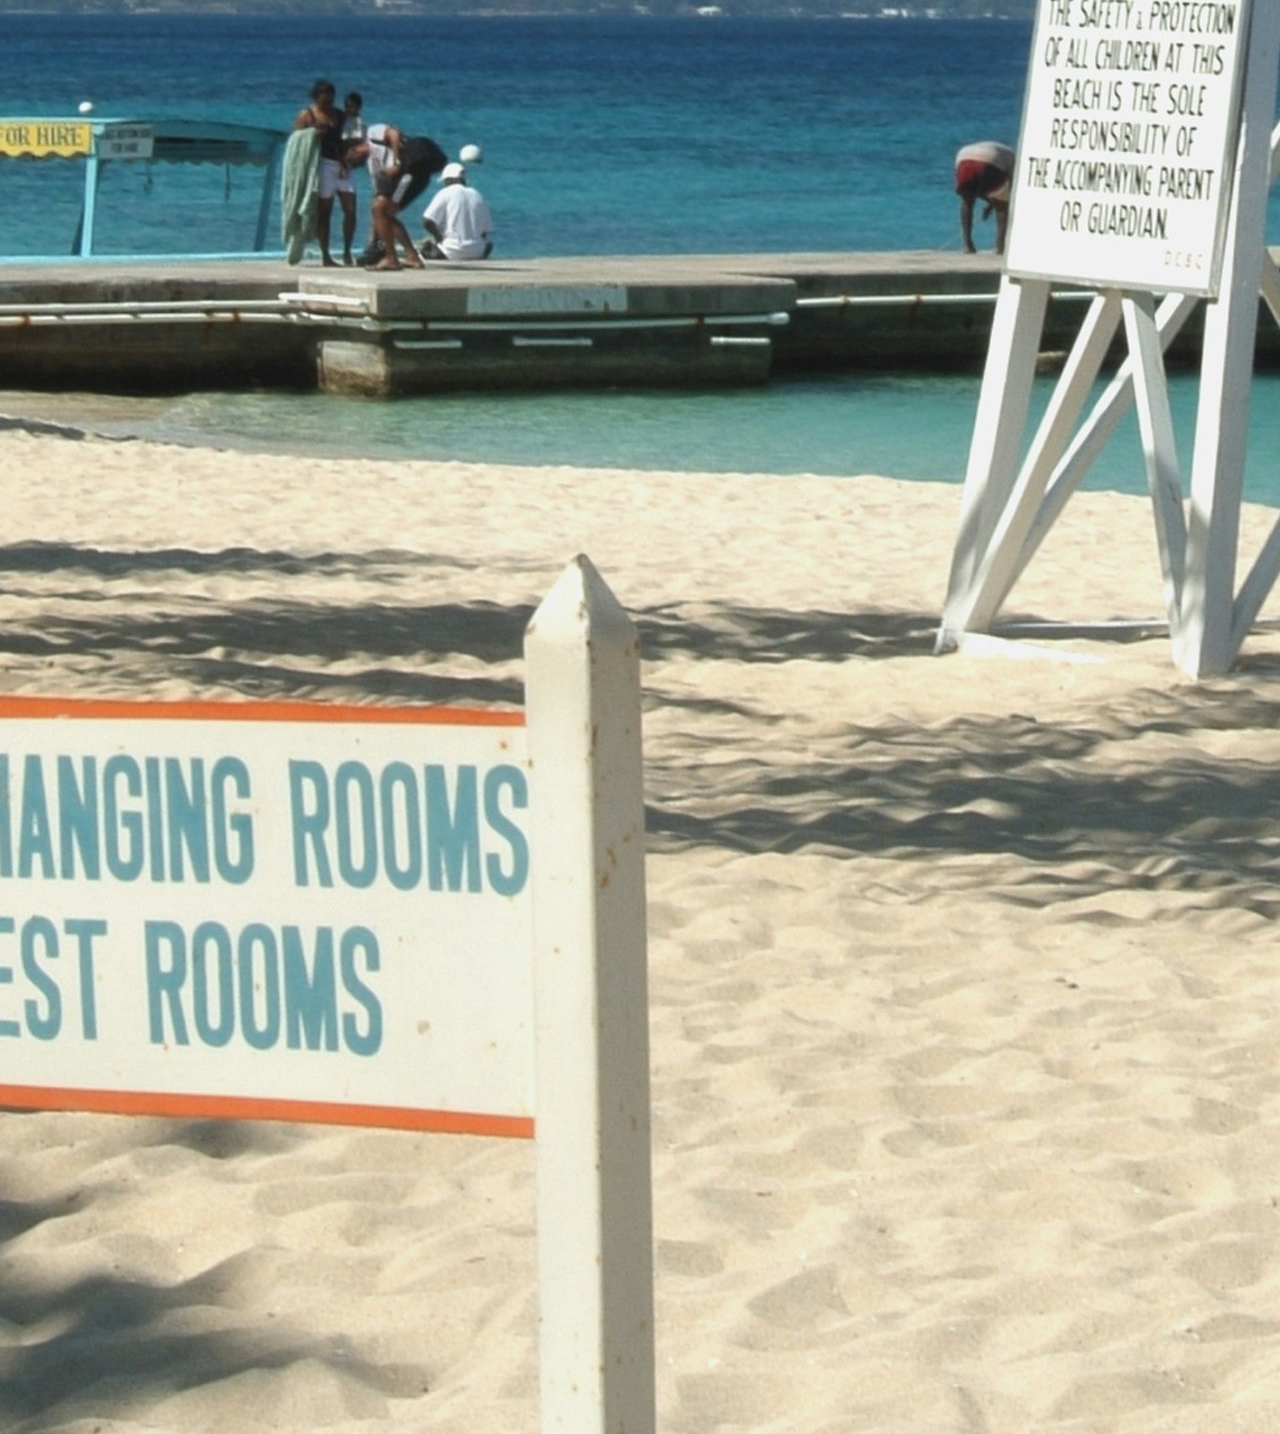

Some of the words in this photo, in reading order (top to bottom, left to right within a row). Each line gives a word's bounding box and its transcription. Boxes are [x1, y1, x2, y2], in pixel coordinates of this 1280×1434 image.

[1149, 1, 1235, 35] PROTECTION
[1044, 37, 1060, 67] OF
[1066, 38, 1088, 69] ALL
[1095, 39, 1160, 72] CHILDREN
[1163, 43, 1185, 73] AT
[1192, 44, 1225, 75] THIS
[1052, 78, 1101, 110] BEACH
[1107, 81, 1122, 110] IS
[1132, 82, 1159, 113] THE
[1166, 84, 1207, 116] SOLE
[36, 124, 83, 146] HIRE
[1050, 119, 1170, 154] RESPONSIBILITY
[1176, 126, 1198, 156] OF
[1028, 157, 1050, 188] THE
[1052, 159, 1153, 196] ACCOMPANYING
[1158, 168, 1214, 200] PARENT
[1060, 201, 1082, 232] OR
[288, 758, 531, 898] ROOMS
[142, 919, 384, 1058] ROOMS
